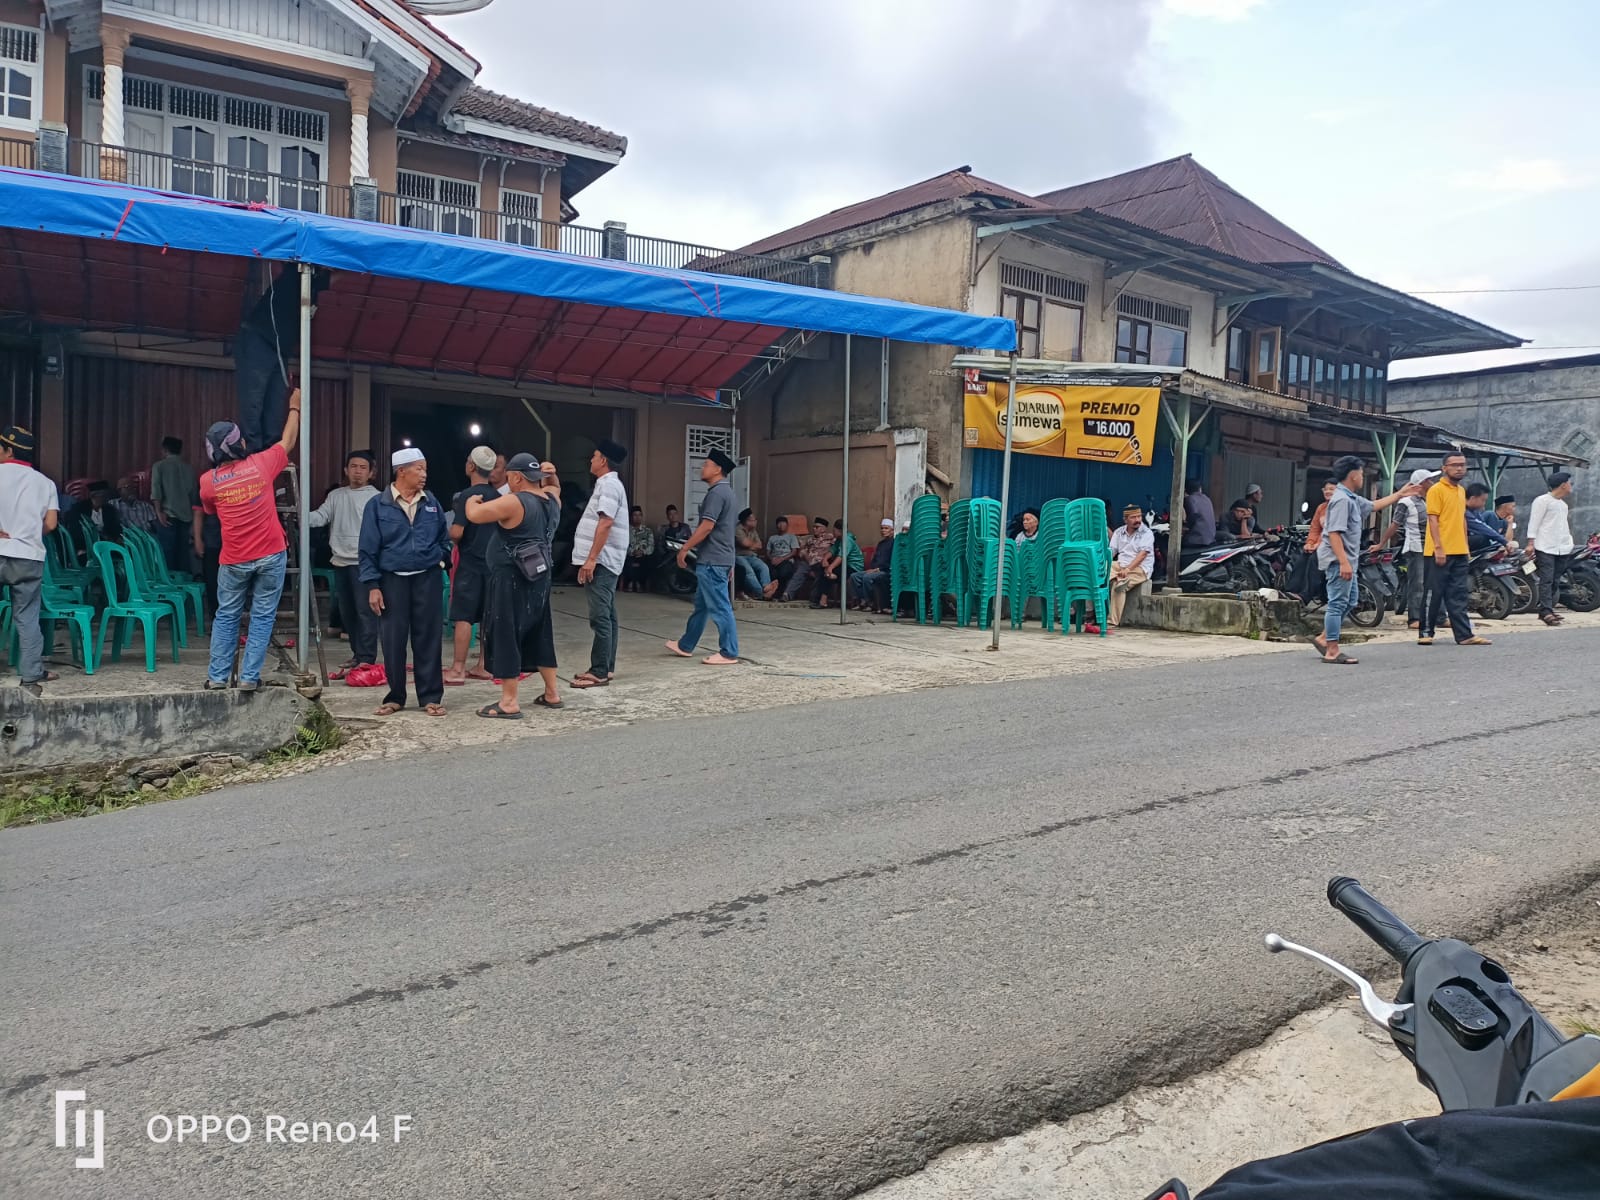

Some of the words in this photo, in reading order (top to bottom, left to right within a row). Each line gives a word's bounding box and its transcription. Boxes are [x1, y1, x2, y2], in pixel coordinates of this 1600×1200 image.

[1018, 401, 1060, 415] DJARUM
[1080, 401, 1140, 416] PREMIO
[997, 410, 1061, 430] Isimewa
[1095, 420, 1131, 437] 16.000
